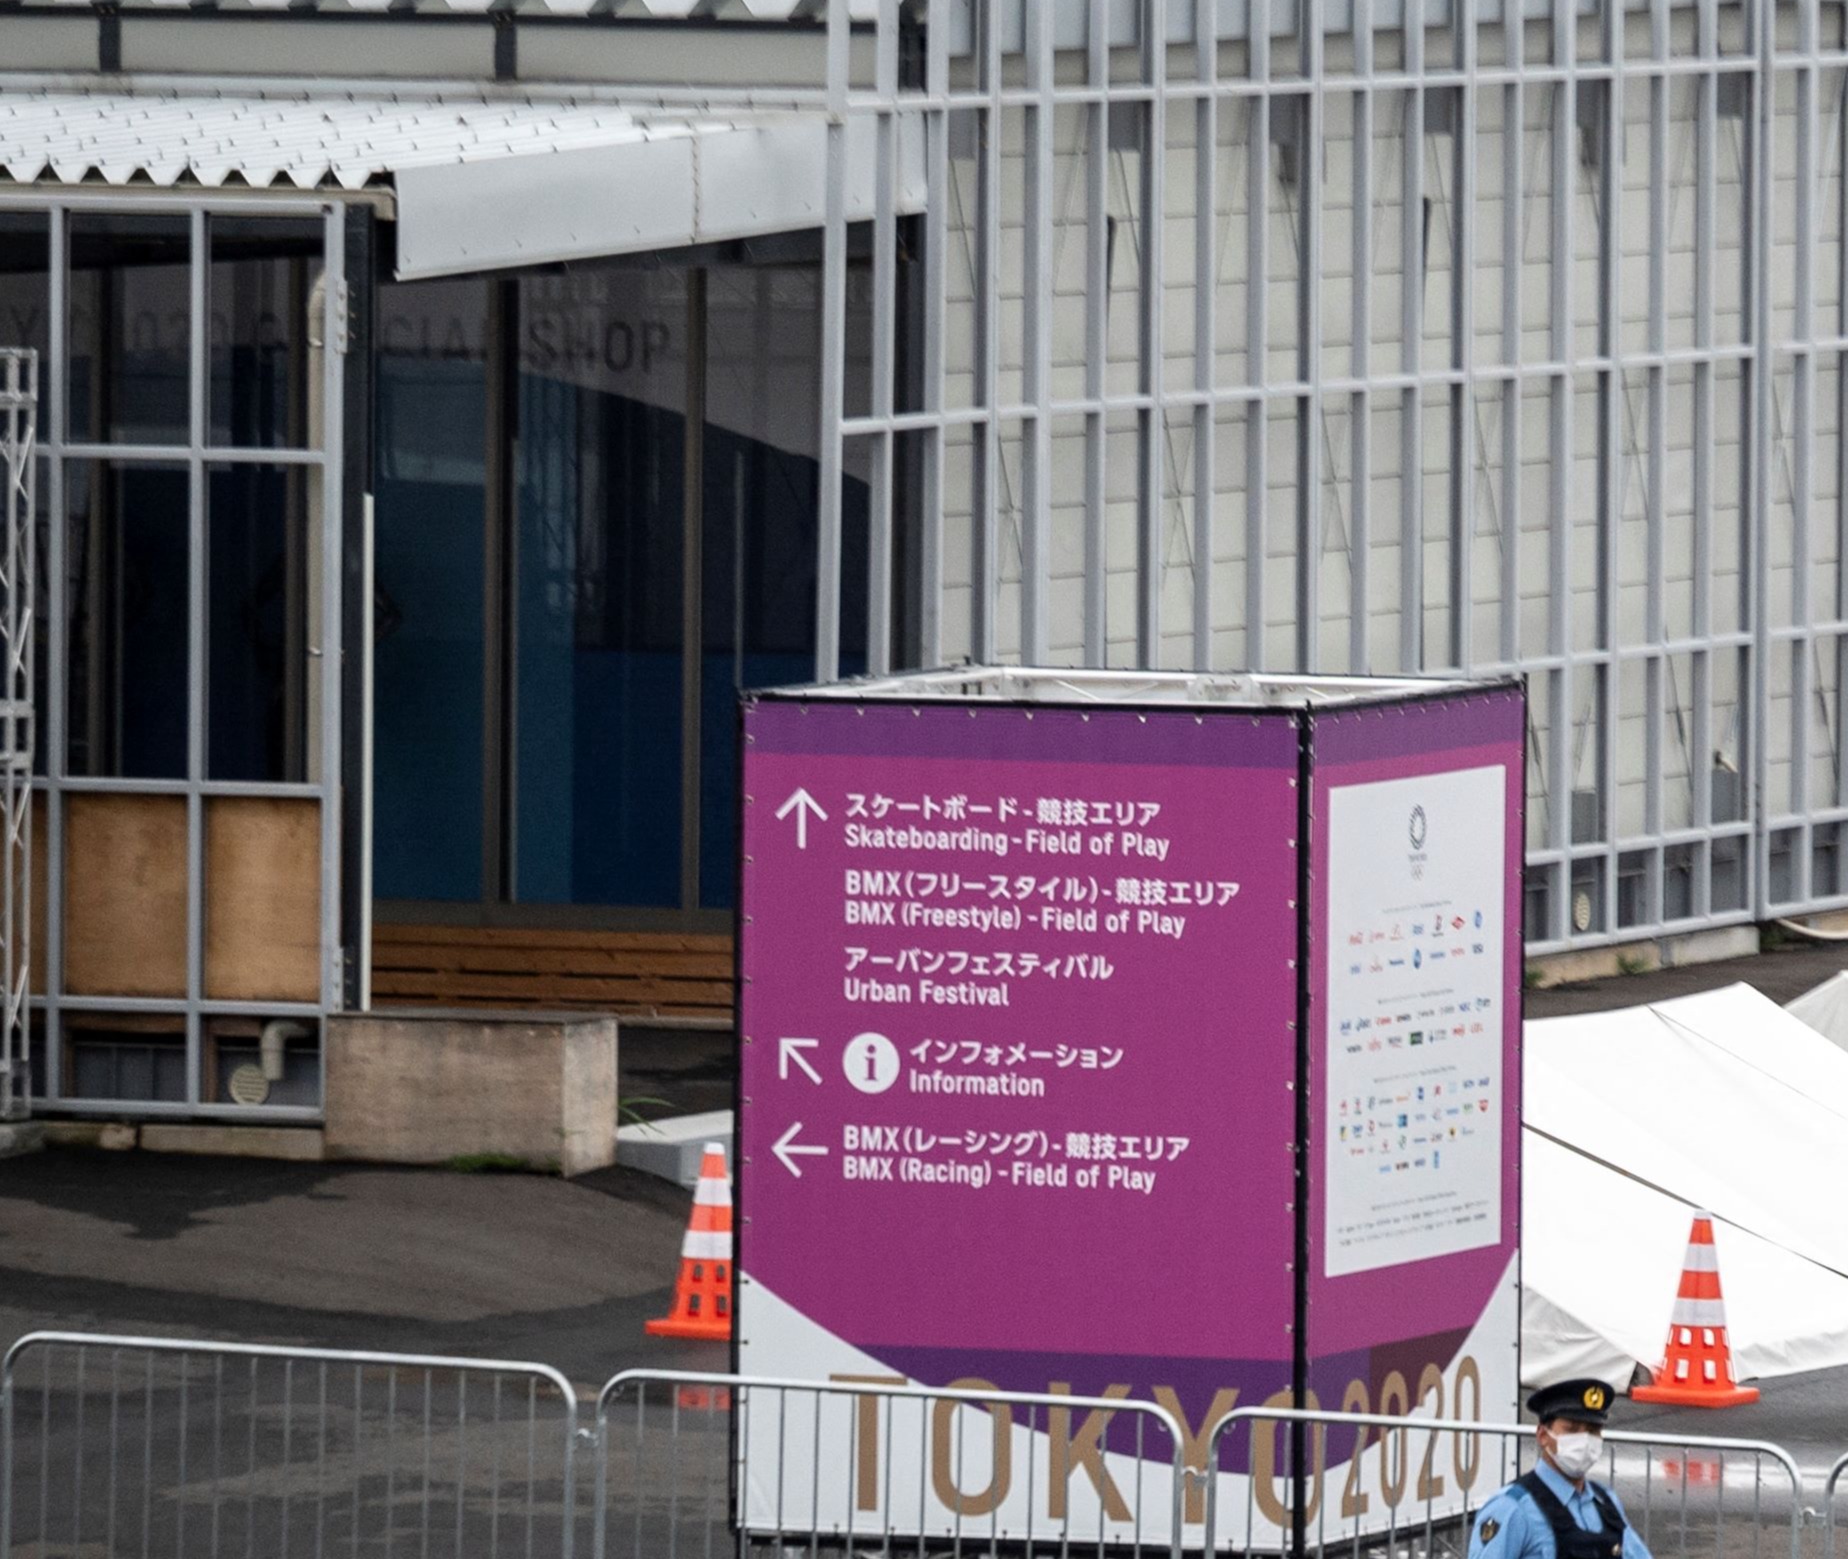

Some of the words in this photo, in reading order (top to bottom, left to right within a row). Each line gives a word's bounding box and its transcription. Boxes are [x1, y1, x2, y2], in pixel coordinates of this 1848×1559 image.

[844, 822, 1008, 857] Skateboarding
[1025, 828, 1082, 855] Field
[1089, 831, 1114, 856] of
[1121, 831, 1170, 862] Play
[844, 900, 895, 927] BMX
[902, 901, 1022, 934] (Freestyle)
[1041, 906, 1098, 932] Field
[1105, 909, 1130, 934] of
[1137, 909, 1186, 940] Play
[844, 946, 1114, 982] アーバンフェスティバル
[844, 977, 911, 1004] Urban
[919, 979, 1010, 1007] Festival
[909, 1038, 1125, 1071] インフォメーション
[909, 1068, 1046, 1097] Information
[842, 1155, 894, 1182] BMX
[900, 1157, 992, 1189] (Racing)
[1011, 1163, 1068, 1188] Field
[1076, 1165, 1101, 1190] of
[1107, 1165, 1156, 1195] Play
[829, 1373, 1322, 1529] TOKYO
[1341, 1355, 1481, 1519] 2020
